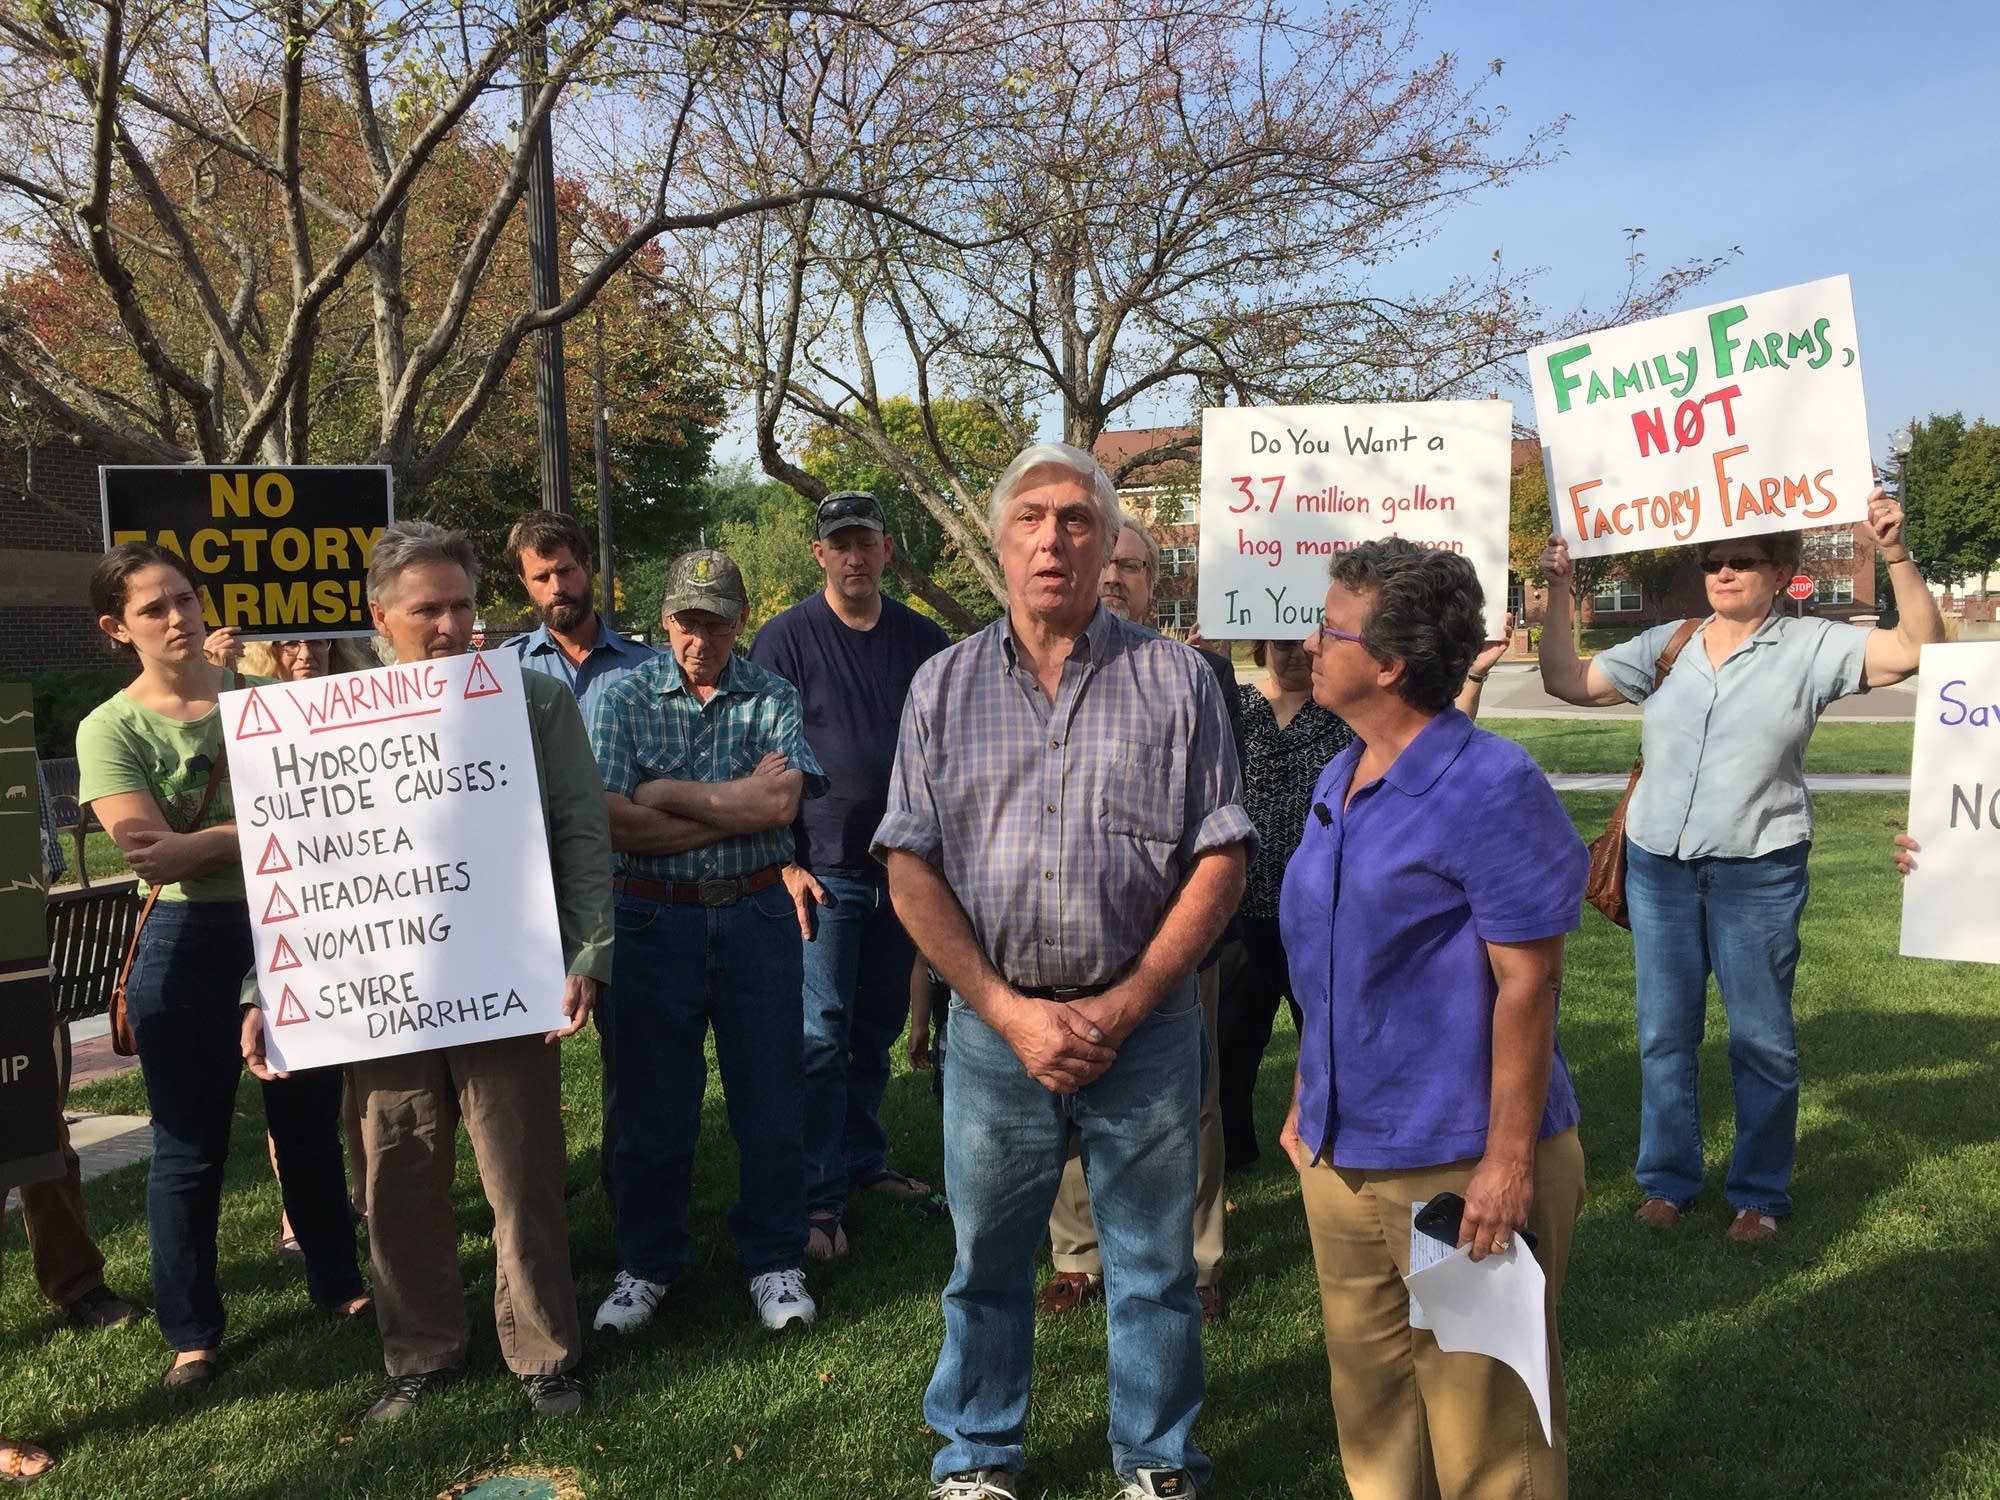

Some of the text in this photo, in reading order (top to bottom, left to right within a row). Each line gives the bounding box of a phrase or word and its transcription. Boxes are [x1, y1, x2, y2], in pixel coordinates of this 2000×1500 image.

[1547, 304, 1855, 414] FAMILY FARMS,
[1251, 425, 1444, 456] Do You Want a
[209, 473, 294, 518] NO
[1228, 475, 1455, 524] 3.7 million gallon
[1569, 444, 1837, 541] FACTORY FARMS
[1237, 528, 1282, 567] hog
[200, 580, 361, 627] ARMS!
[1225, 586, 1325, 625] In Your
[1789, 583, 1811, 592] STOP
[285, 665, 448, 727] WARNING
[272, 733, 440, 788] HYDROGEN
[251, 760, 508, 827] SULFIDE CAUSES:
[297, 826, 414, 867] NAUSEA
[301, 862, 471, 914] HEADACHES
[304, 913, 451, 962] VOMITING
[315, 972, 419, 1019] SEVERE
[367, 988, 528, 1039] DIARRHEA
